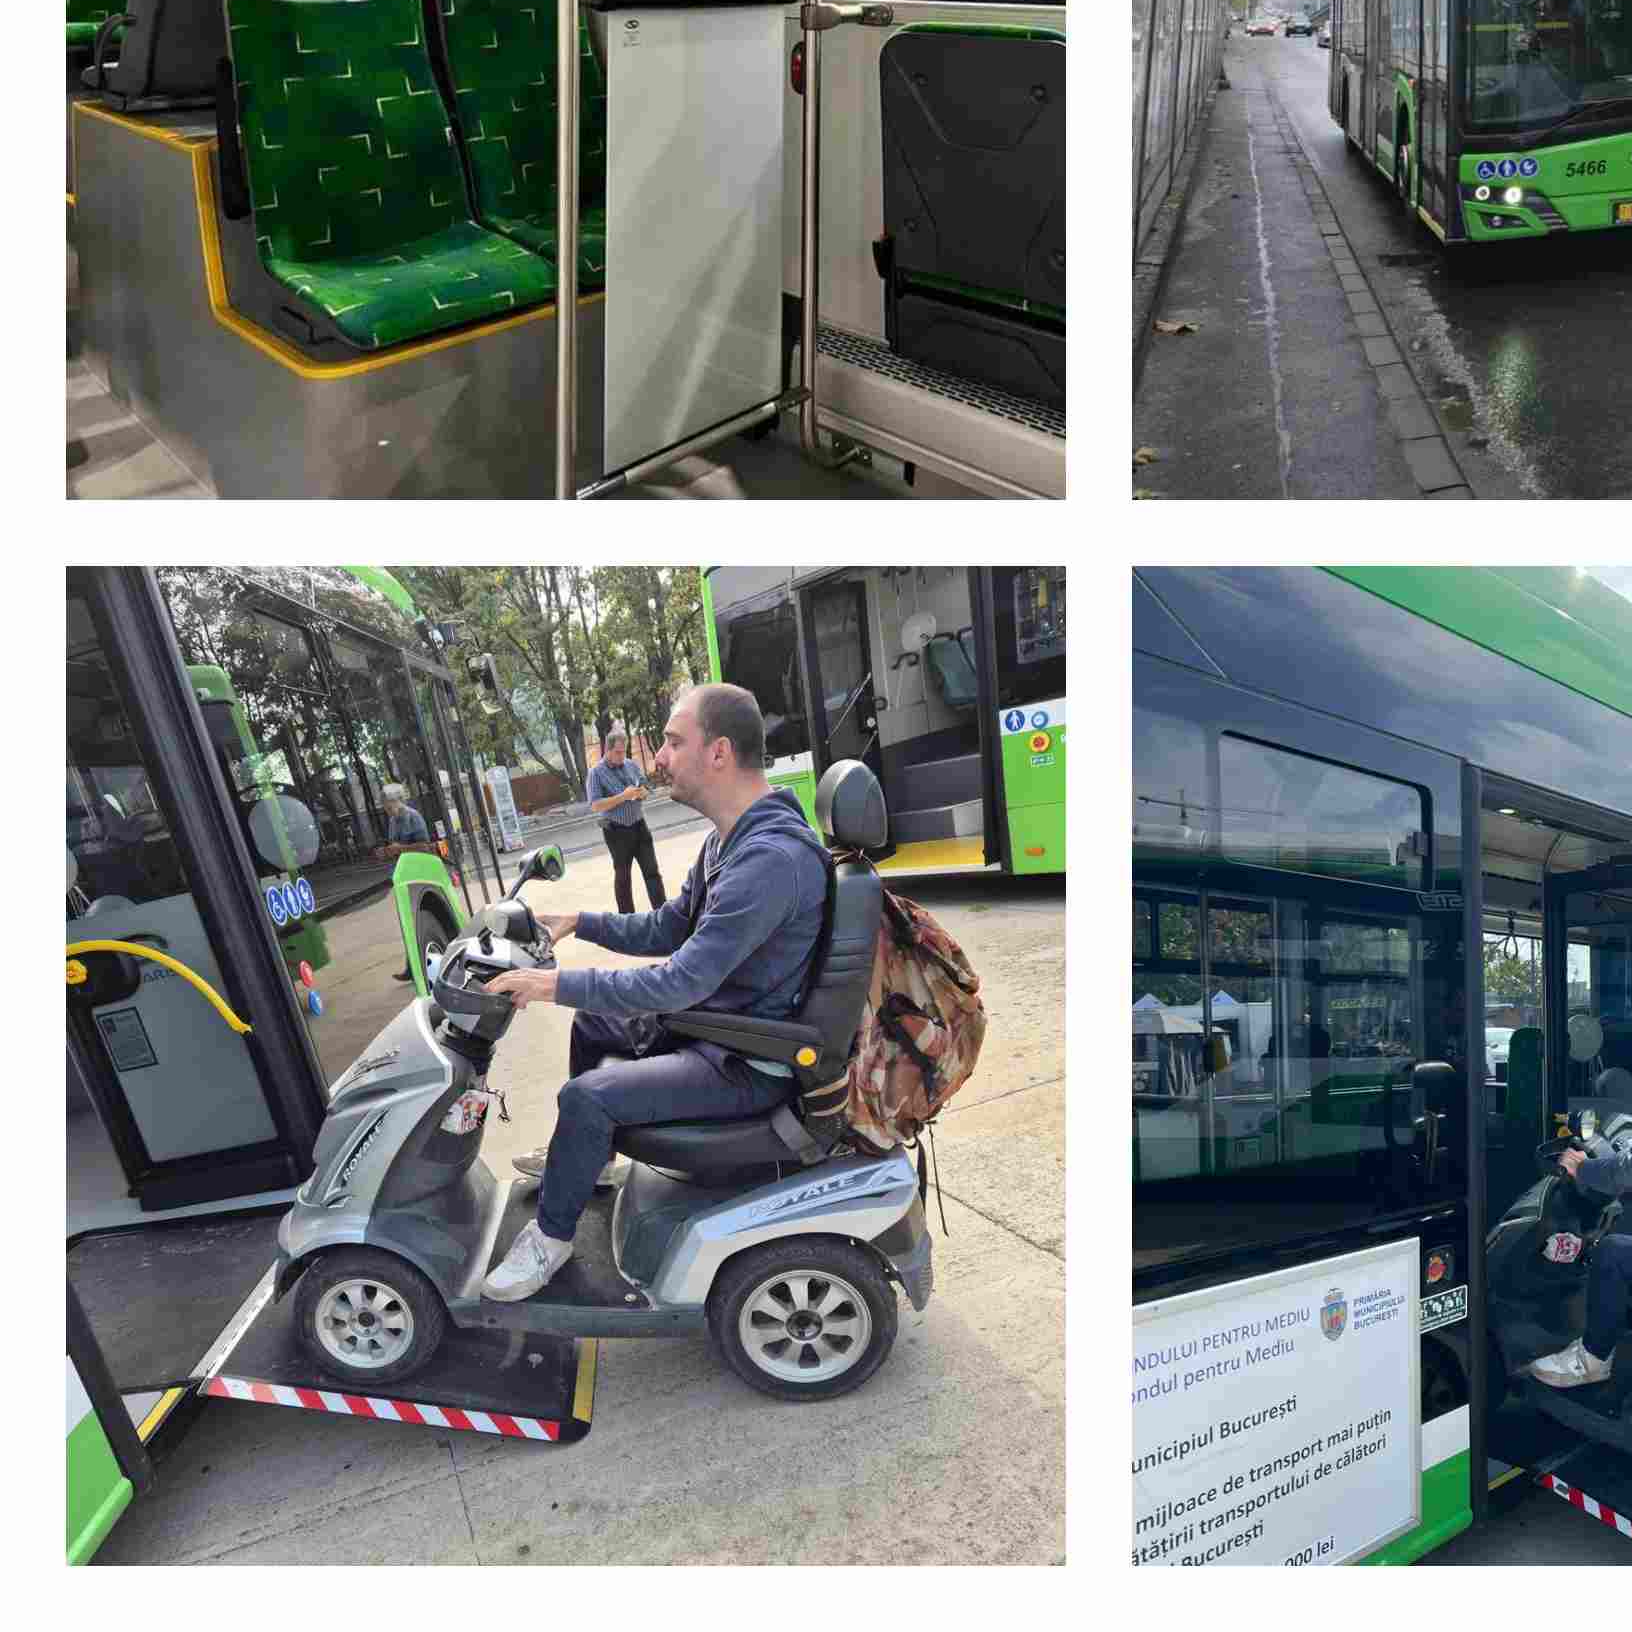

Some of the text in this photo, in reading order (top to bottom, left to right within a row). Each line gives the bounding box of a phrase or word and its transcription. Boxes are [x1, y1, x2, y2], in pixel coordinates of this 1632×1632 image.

[1566, 160, 1607, 178] 5466
[1203, 1325, 1261, 1352] PENTRU
[1265, 1308, 1311, 1332] MEDIU
[1184, 1357, 1240, 1389] pentru
[1246, 1339, 1295, 1366] Mediu
[1136, 1487, 1217, 1535] mijloace
[1223, 1475, 1244, 1494] de
[1249, 1438, 1323, 1483] transport
[1327, 1423, 1353, 1448] mai
[1199, 1470, 1310, 1535] transportului
[1313, 1460, 1332, 1481] de
[1317, 1536, 1334, 1557] lei
